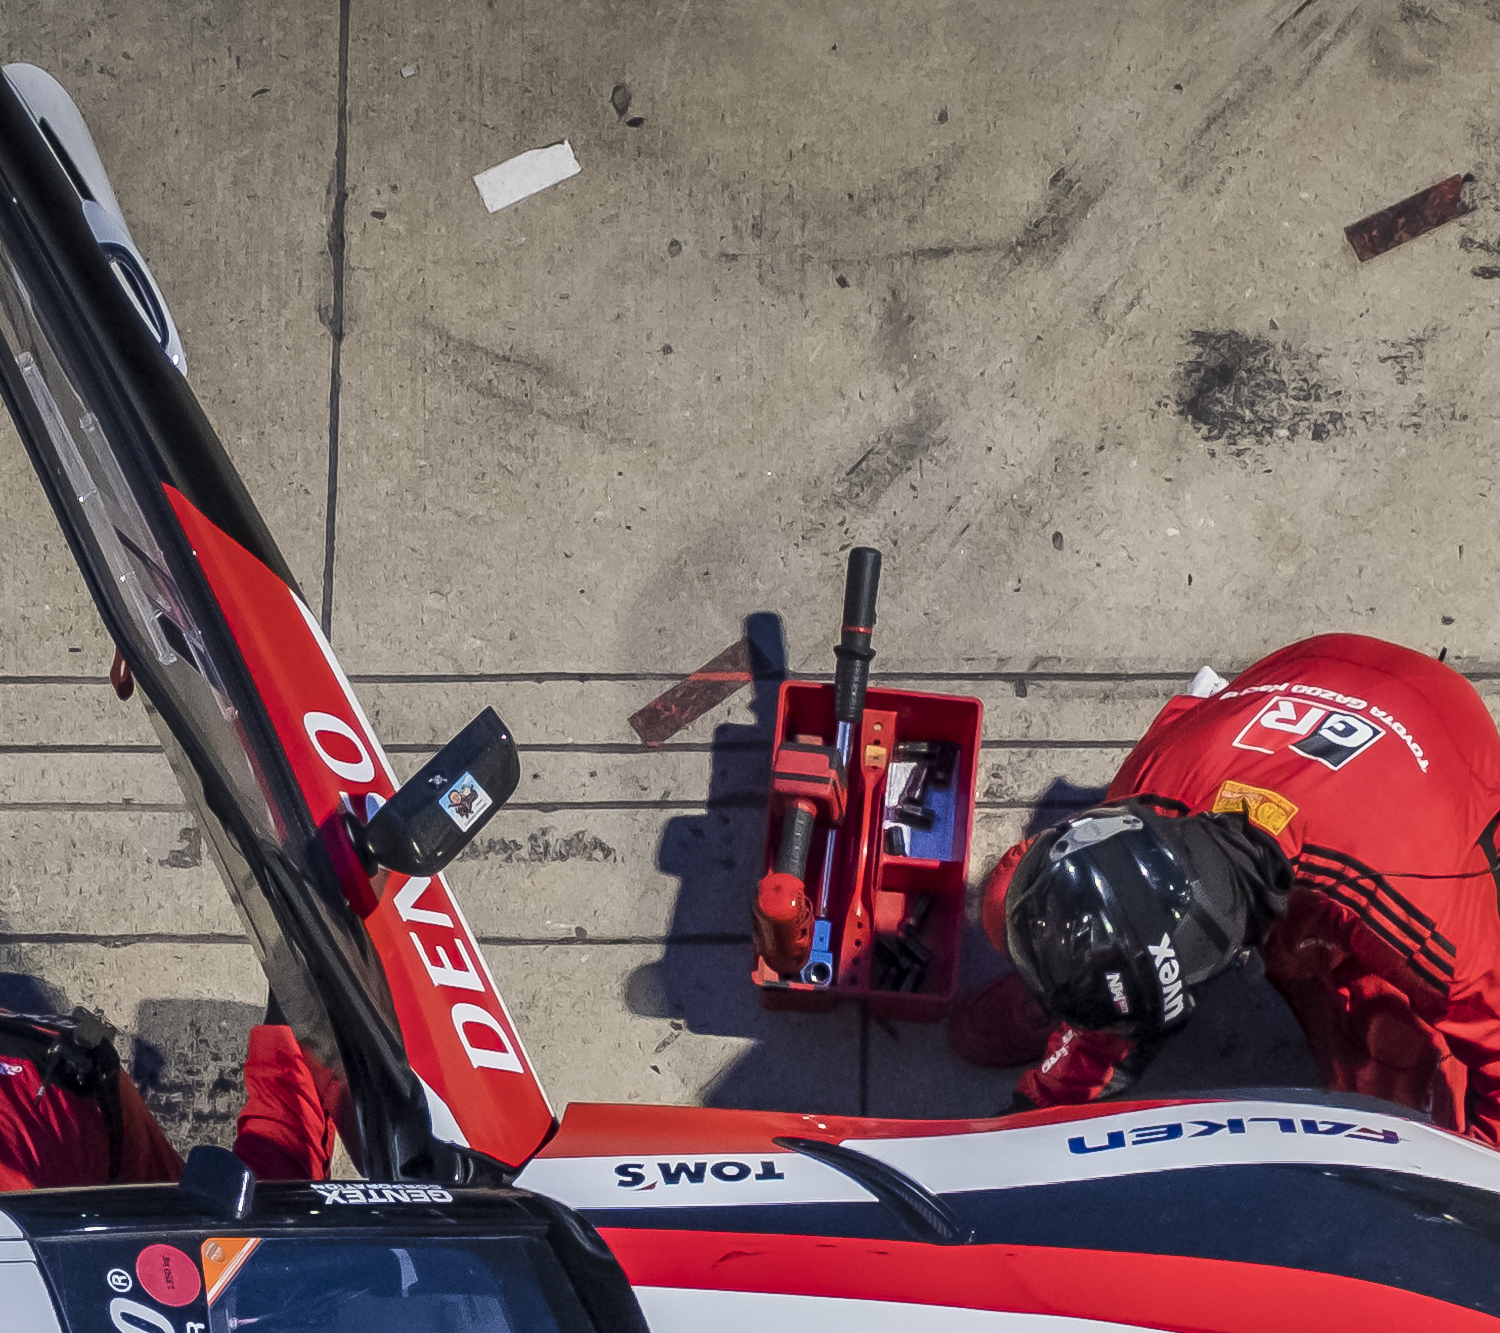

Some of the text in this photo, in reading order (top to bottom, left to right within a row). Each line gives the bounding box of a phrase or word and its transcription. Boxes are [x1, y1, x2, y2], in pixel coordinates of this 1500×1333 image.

[1292, 684, 1371, 711] GAZOO
[1260, 700, 1381, 746] GR
[1368, 705, 1431, 772] TOYOTA
[303, 711, 524, 1074] DENO
[1147, 933, 1187, 1023] uvex
[1067, 1115, 1402, 1157] FALKEN
[322, 1188, 454, 1205] GENTEX
[614, 1160, 786, 1190] TOM'S
